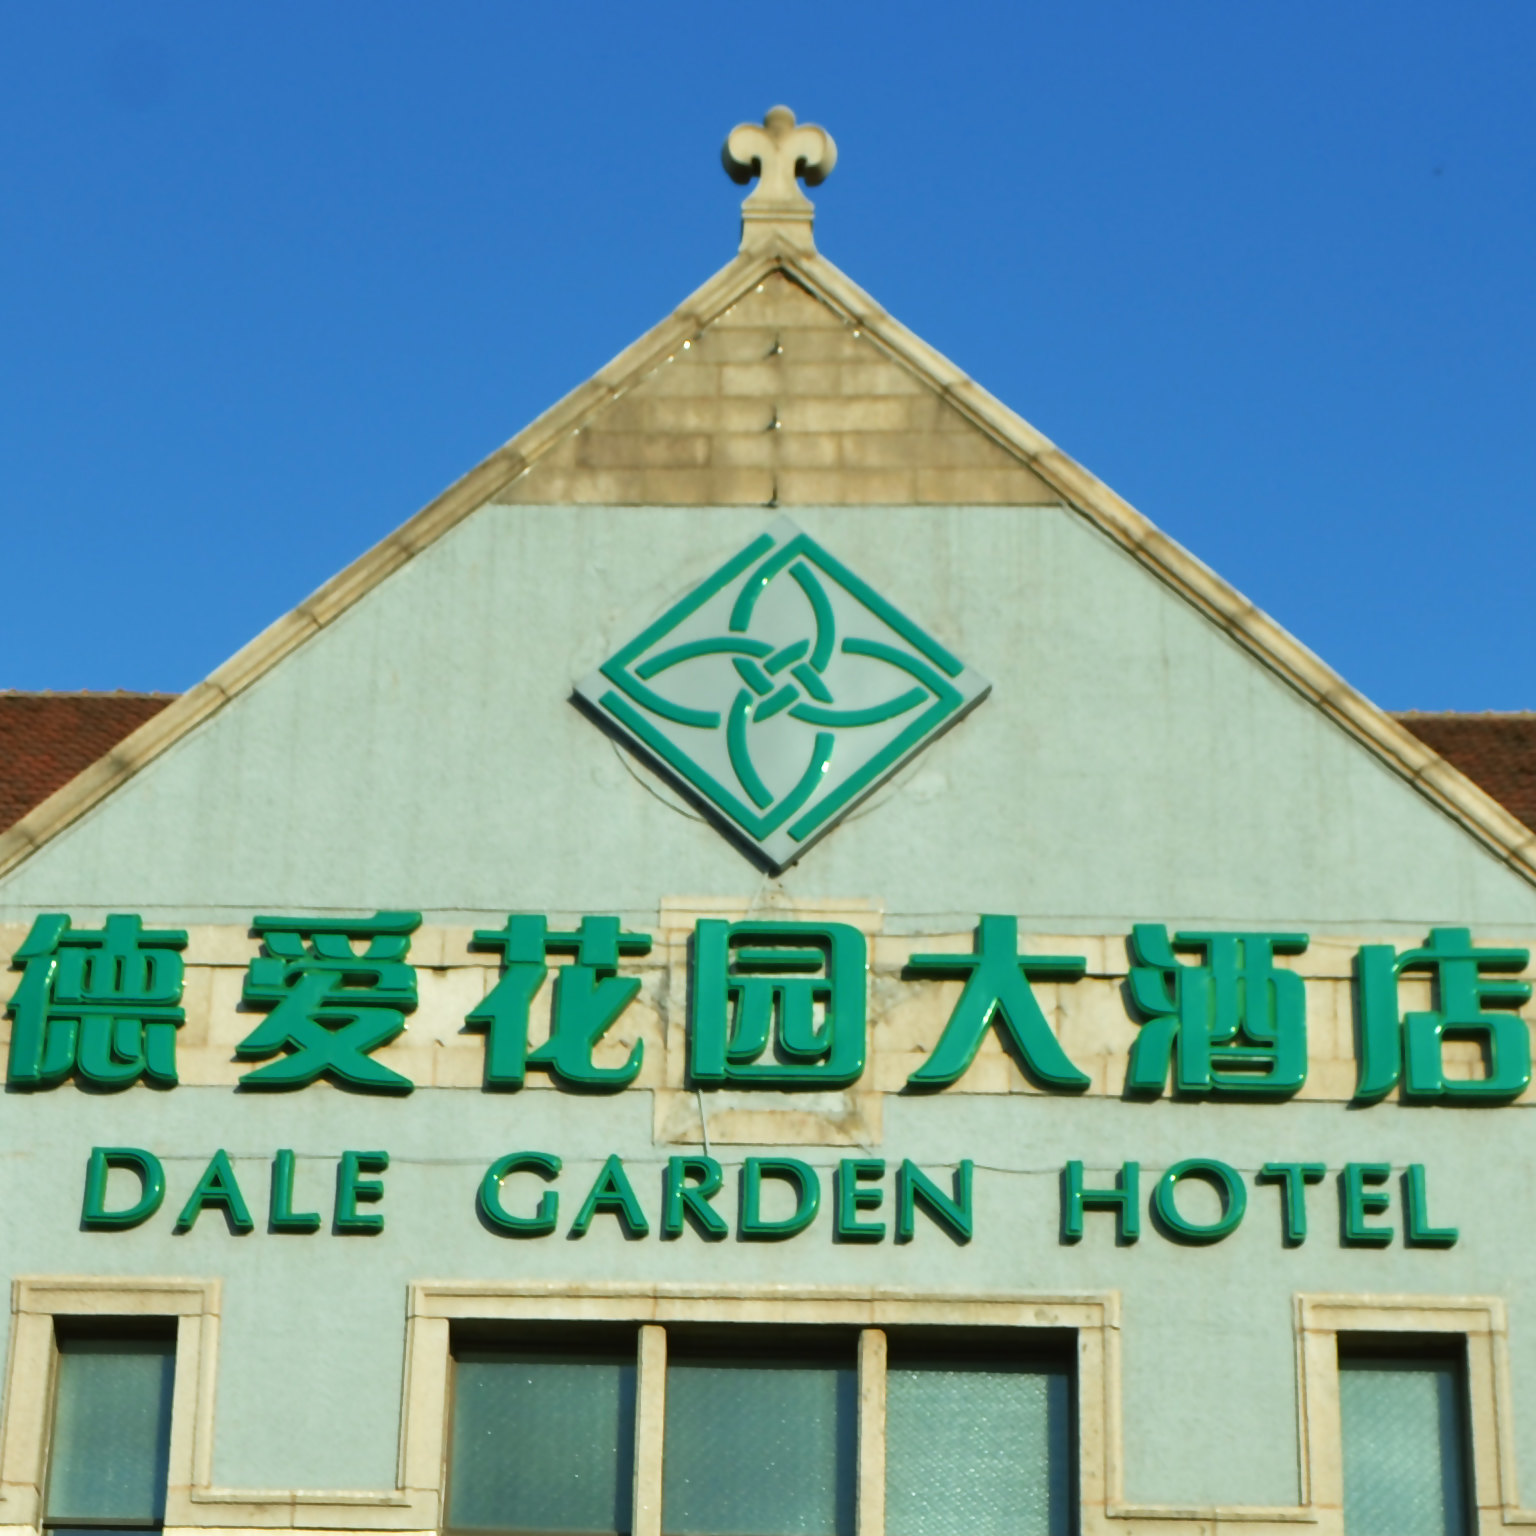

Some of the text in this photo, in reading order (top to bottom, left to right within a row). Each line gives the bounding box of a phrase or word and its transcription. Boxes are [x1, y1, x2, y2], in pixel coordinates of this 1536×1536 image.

[7, 911, 1531, 1100] 德爱花园大酒店
[81, 1147, 1459, 1248] DALE GARDEN HOTEL
